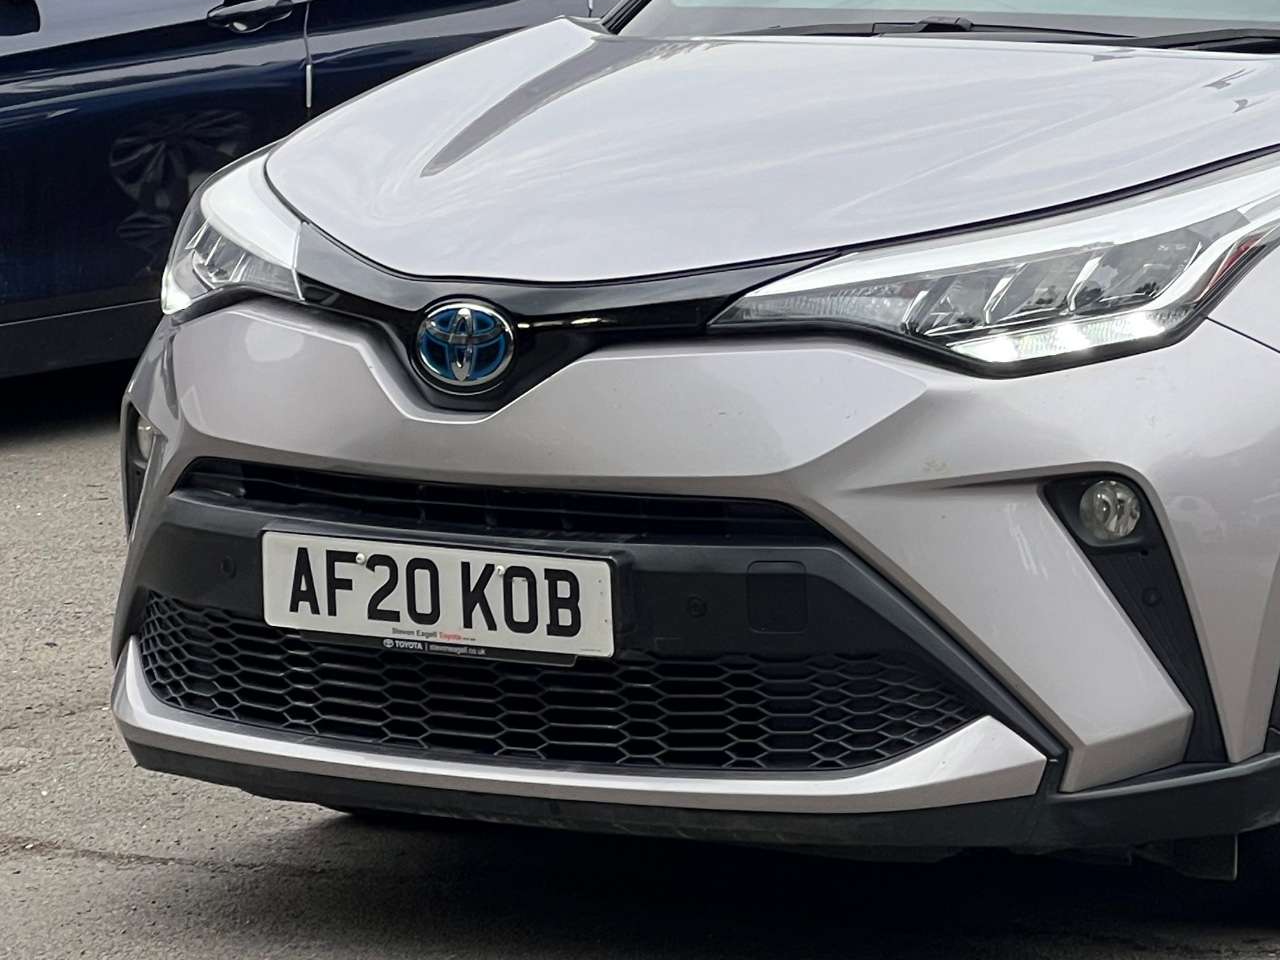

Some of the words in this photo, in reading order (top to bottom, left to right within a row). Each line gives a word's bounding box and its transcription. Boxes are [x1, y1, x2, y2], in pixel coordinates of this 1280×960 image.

[289, 546, 441, 626] AF20
[460, 560, 582, 638] KOB
[394, 640, 424, 650] TOYOTA
